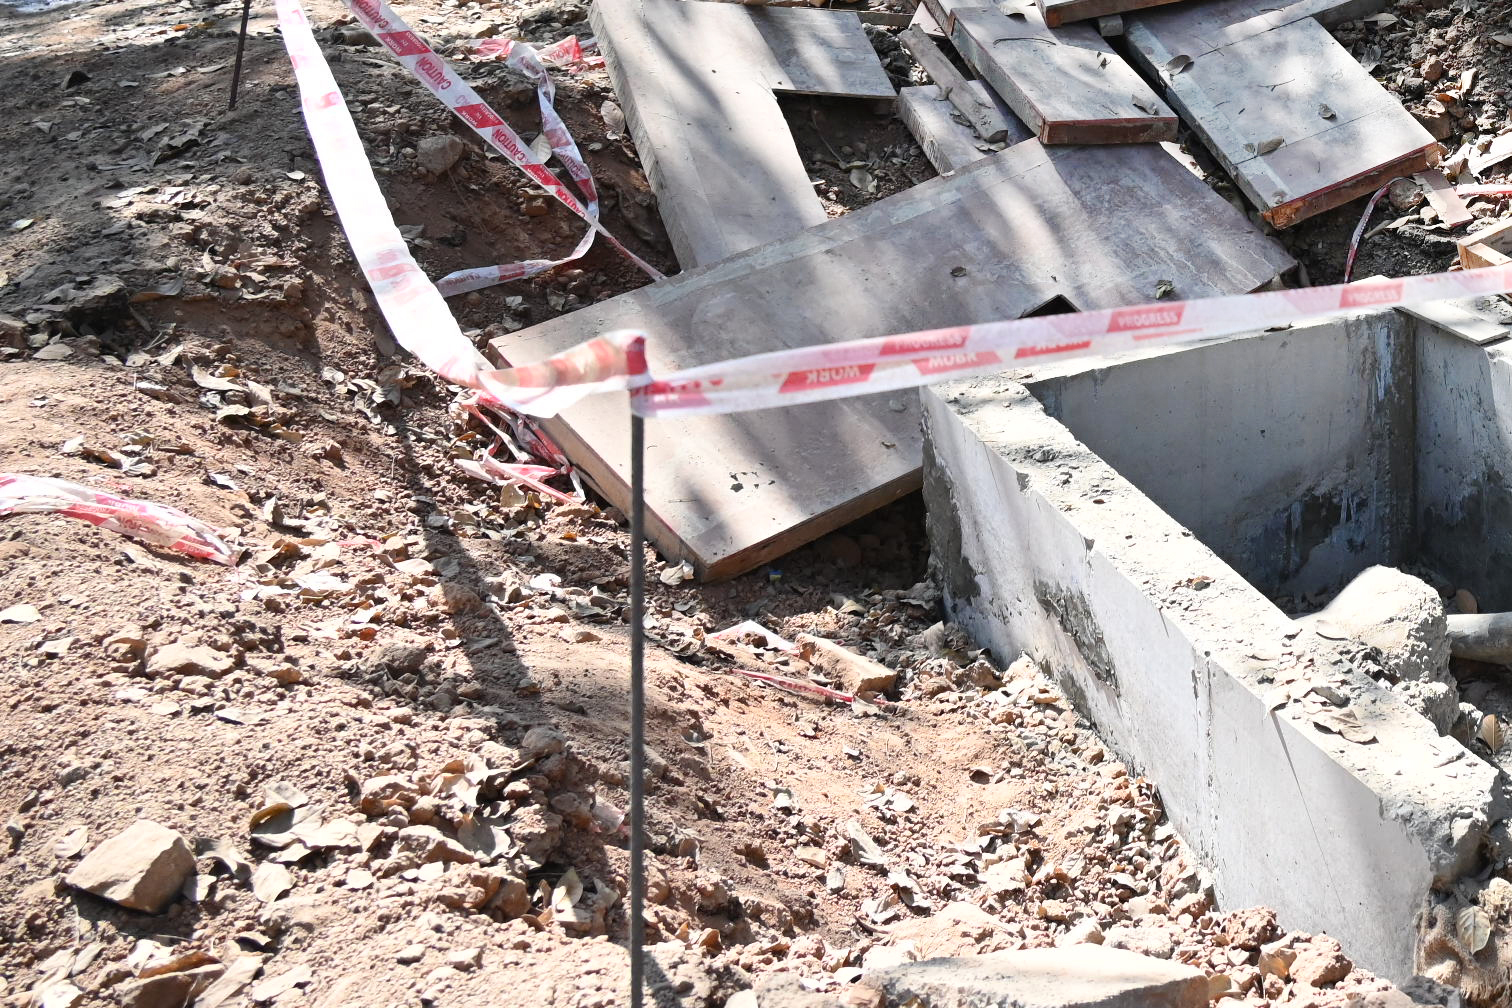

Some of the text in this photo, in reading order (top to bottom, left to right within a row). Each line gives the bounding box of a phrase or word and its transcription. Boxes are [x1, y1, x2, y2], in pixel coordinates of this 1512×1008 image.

[416, 57, 452, 91] CAUTION
[492, 129, 527, 161] CAUTION
[1117, 311, 1179, 328] PROGRESS
